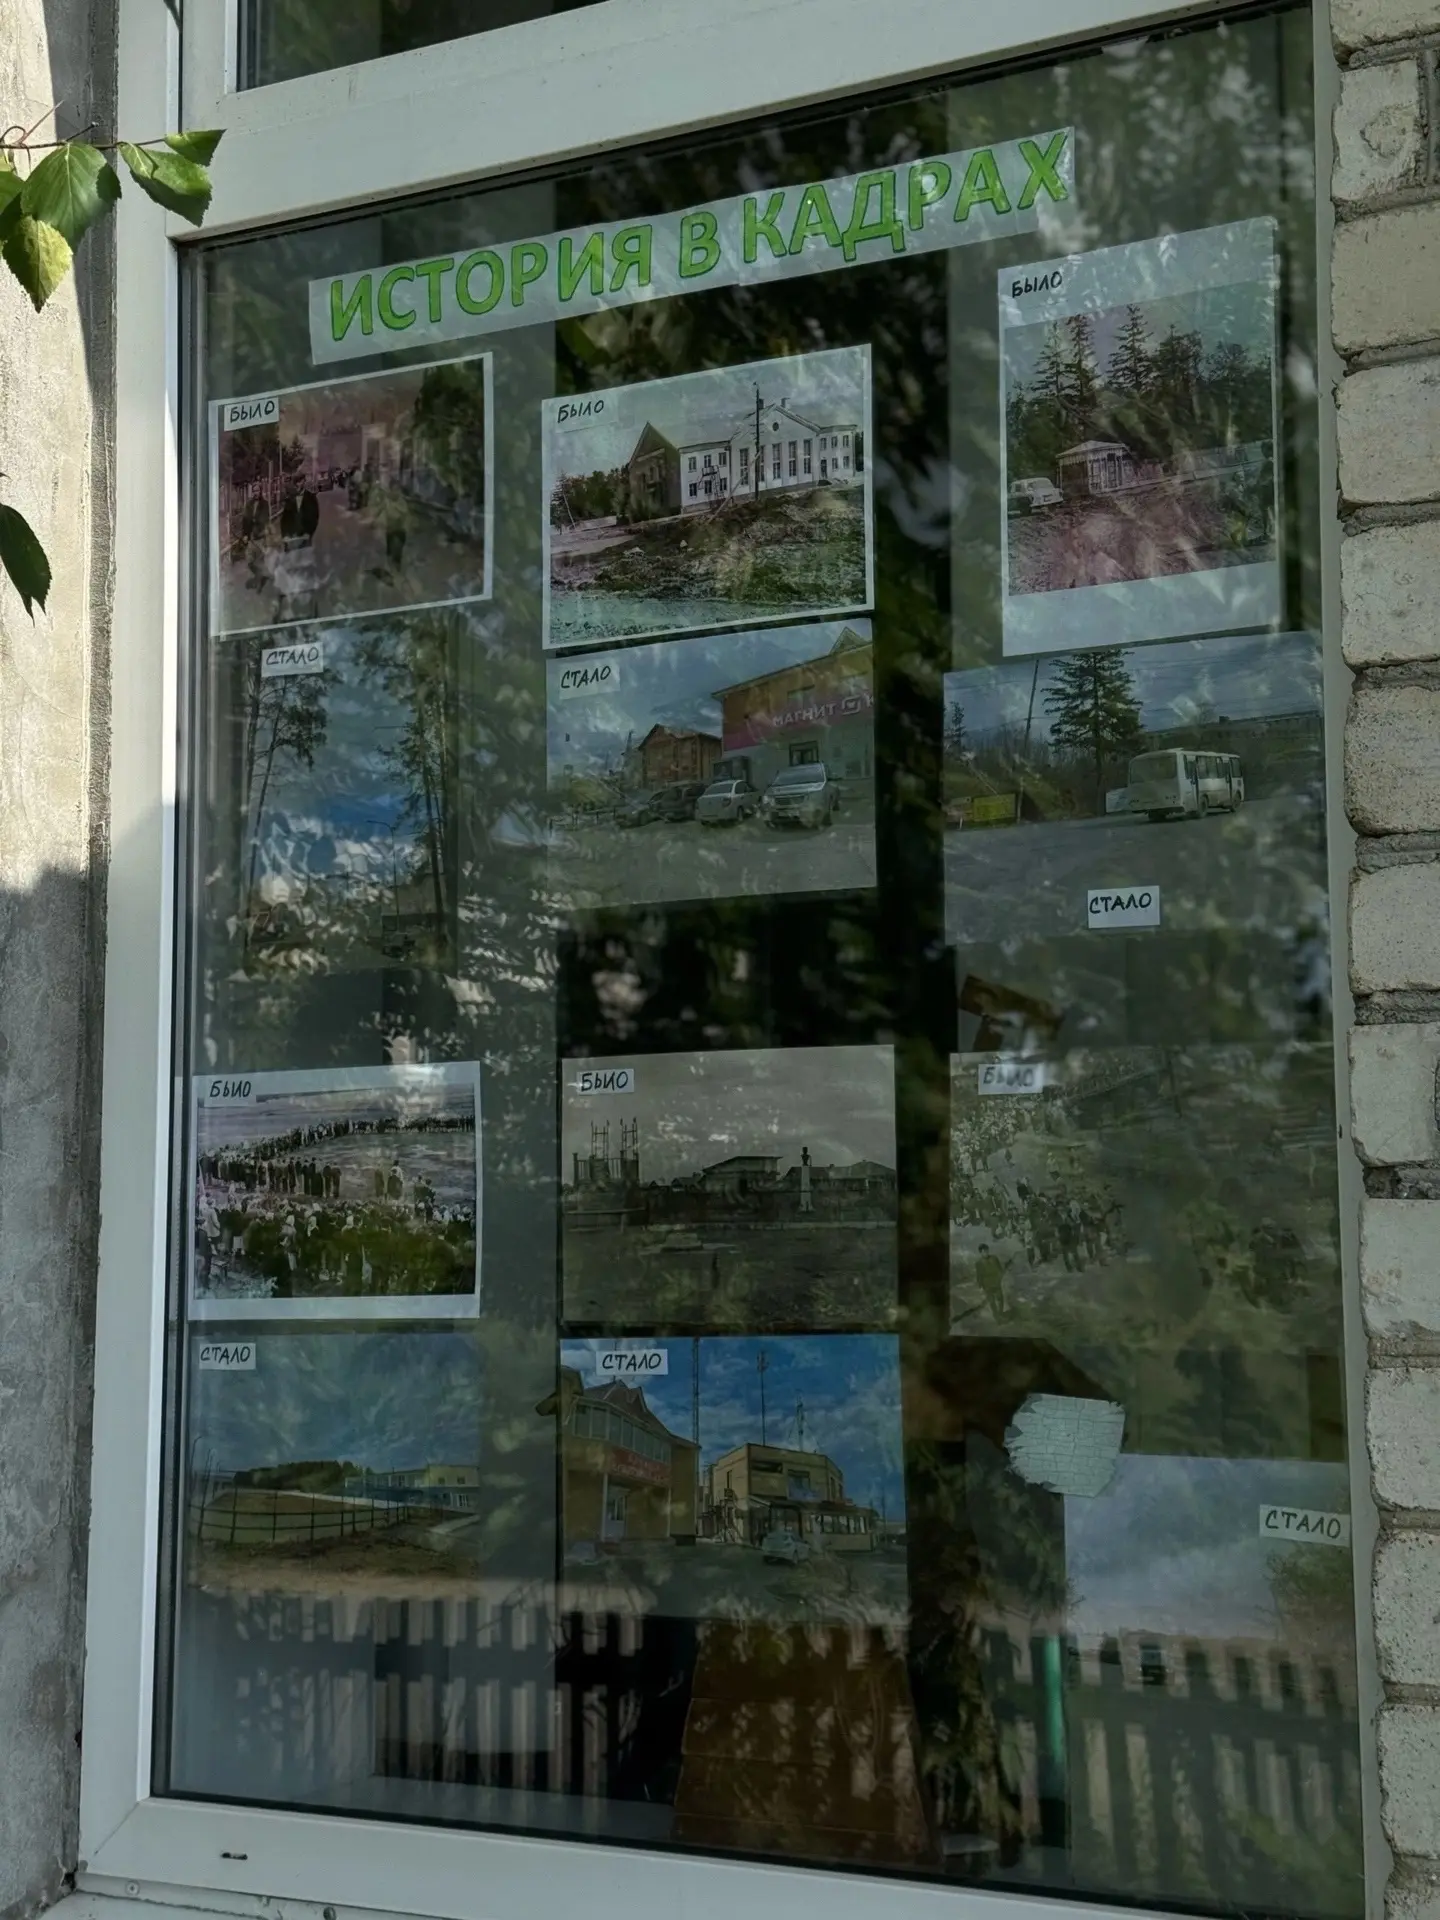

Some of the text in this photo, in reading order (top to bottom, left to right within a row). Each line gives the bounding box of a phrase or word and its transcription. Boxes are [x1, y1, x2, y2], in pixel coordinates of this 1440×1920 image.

[330, 132, 1070, 342] ИСТОРИЯ В КАДРАХ
[1011, 270, 1063, 298] БЫЛО
[229, 400, 276, 423] БЫЛО
[557, 399, 605, 424] БЫЛО
[265, 646, 320, 666] СТАЛО
[560, 665, 612, 689] СТАЛО
[772, 702, 838, 726] МАГНИТ
[1088, 892, 1153, 914] СТАЛО
[200, 1346, 251, 1365] СТАЛО
[601, 1353, 662, 1372] СТАЛО
[1265, 1509, 1342, 1540] СТАЛО
